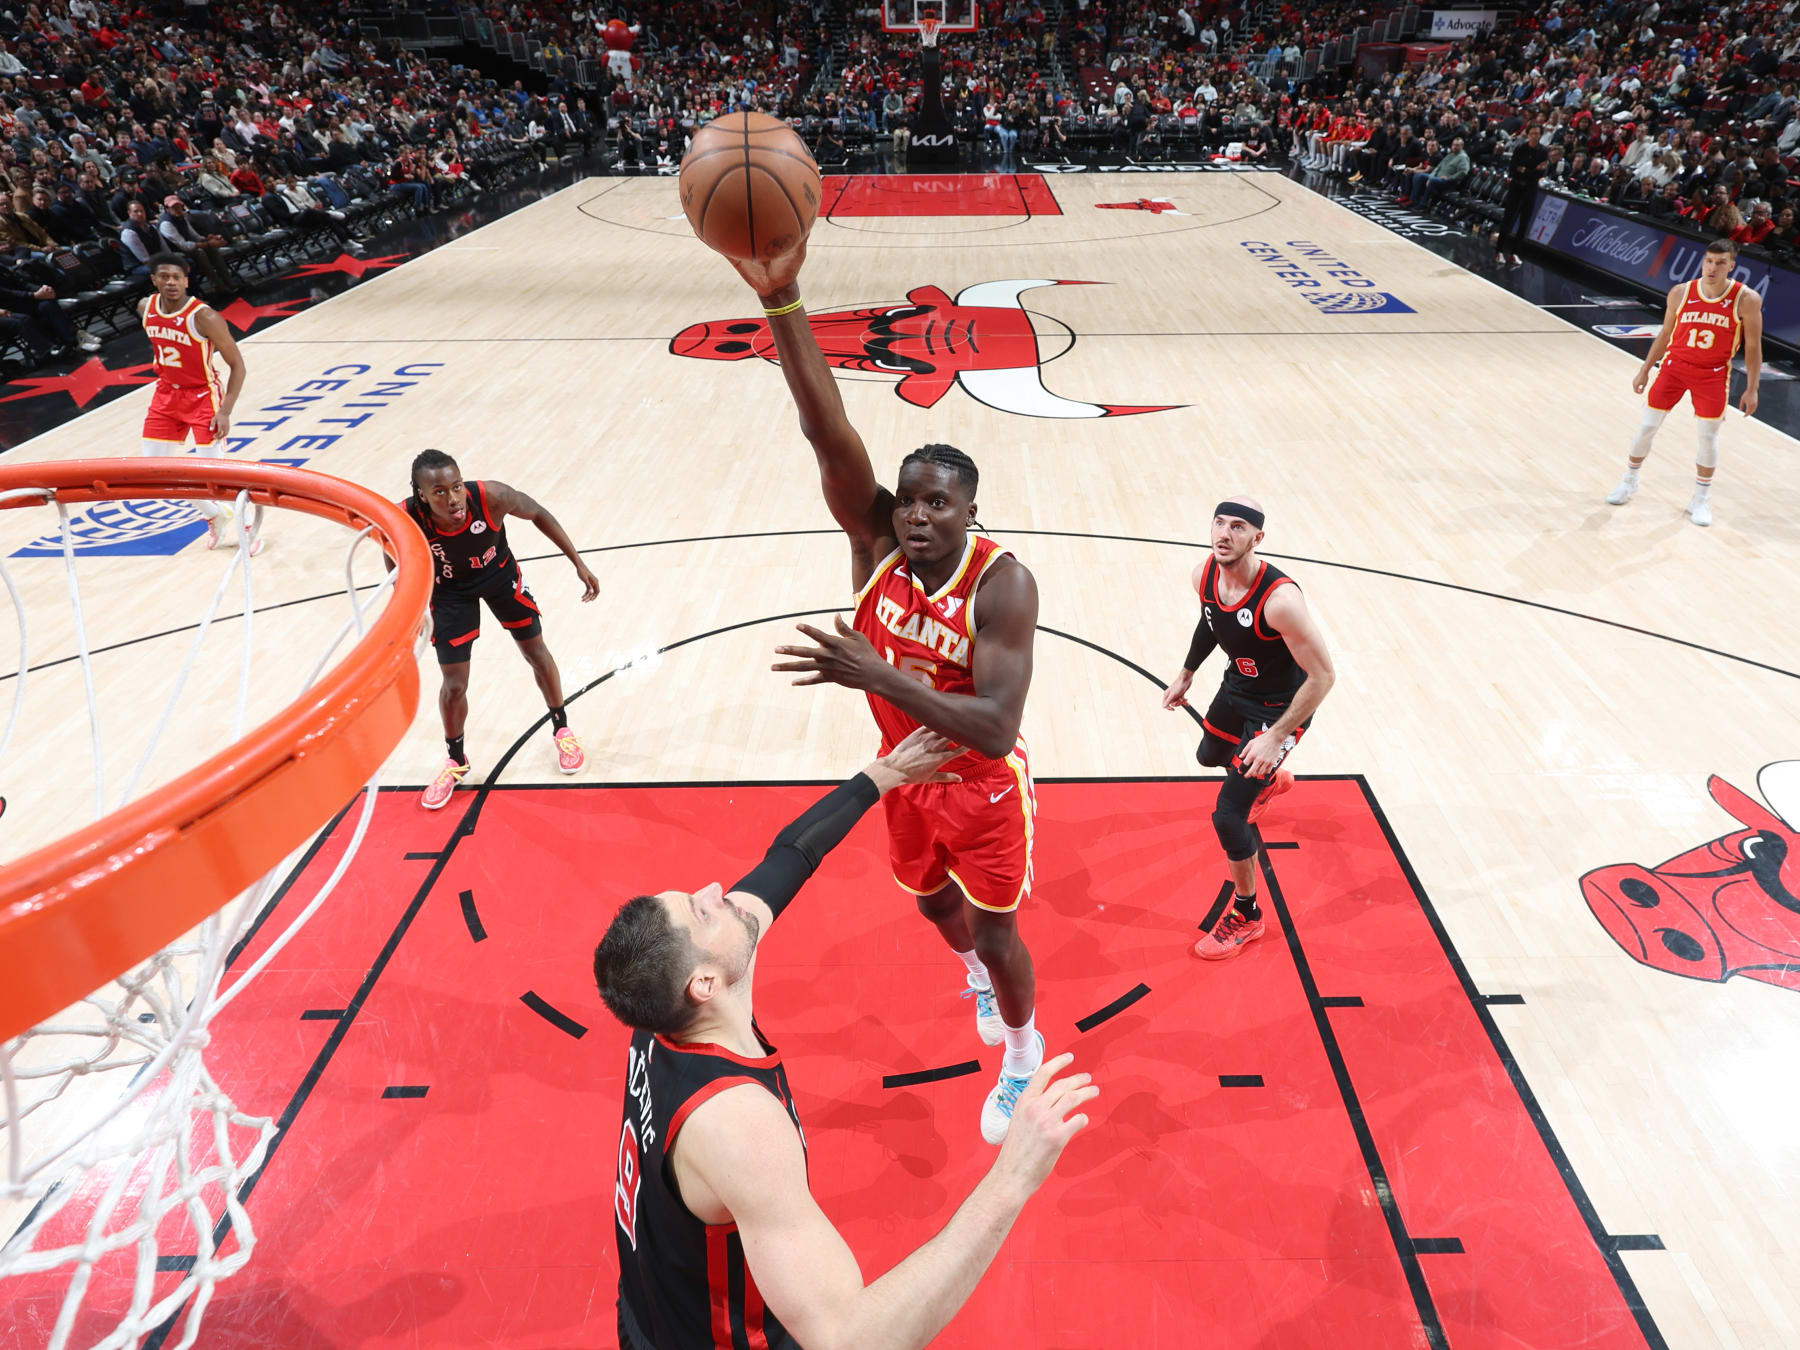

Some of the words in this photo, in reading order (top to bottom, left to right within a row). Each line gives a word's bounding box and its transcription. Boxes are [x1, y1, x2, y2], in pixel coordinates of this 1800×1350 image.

[1571, 218, 1659, 265] Michelob
[1240, 241, 1321, 288] CENTER
[1286, 241, 1376, 288] UNITED
[1680, 312, 1730, 329] ATLANTA
[1686, 328, 1716, 349] 13
[157, 344, 183, 368] 12
[1235, 657, 1259, 678] 6
